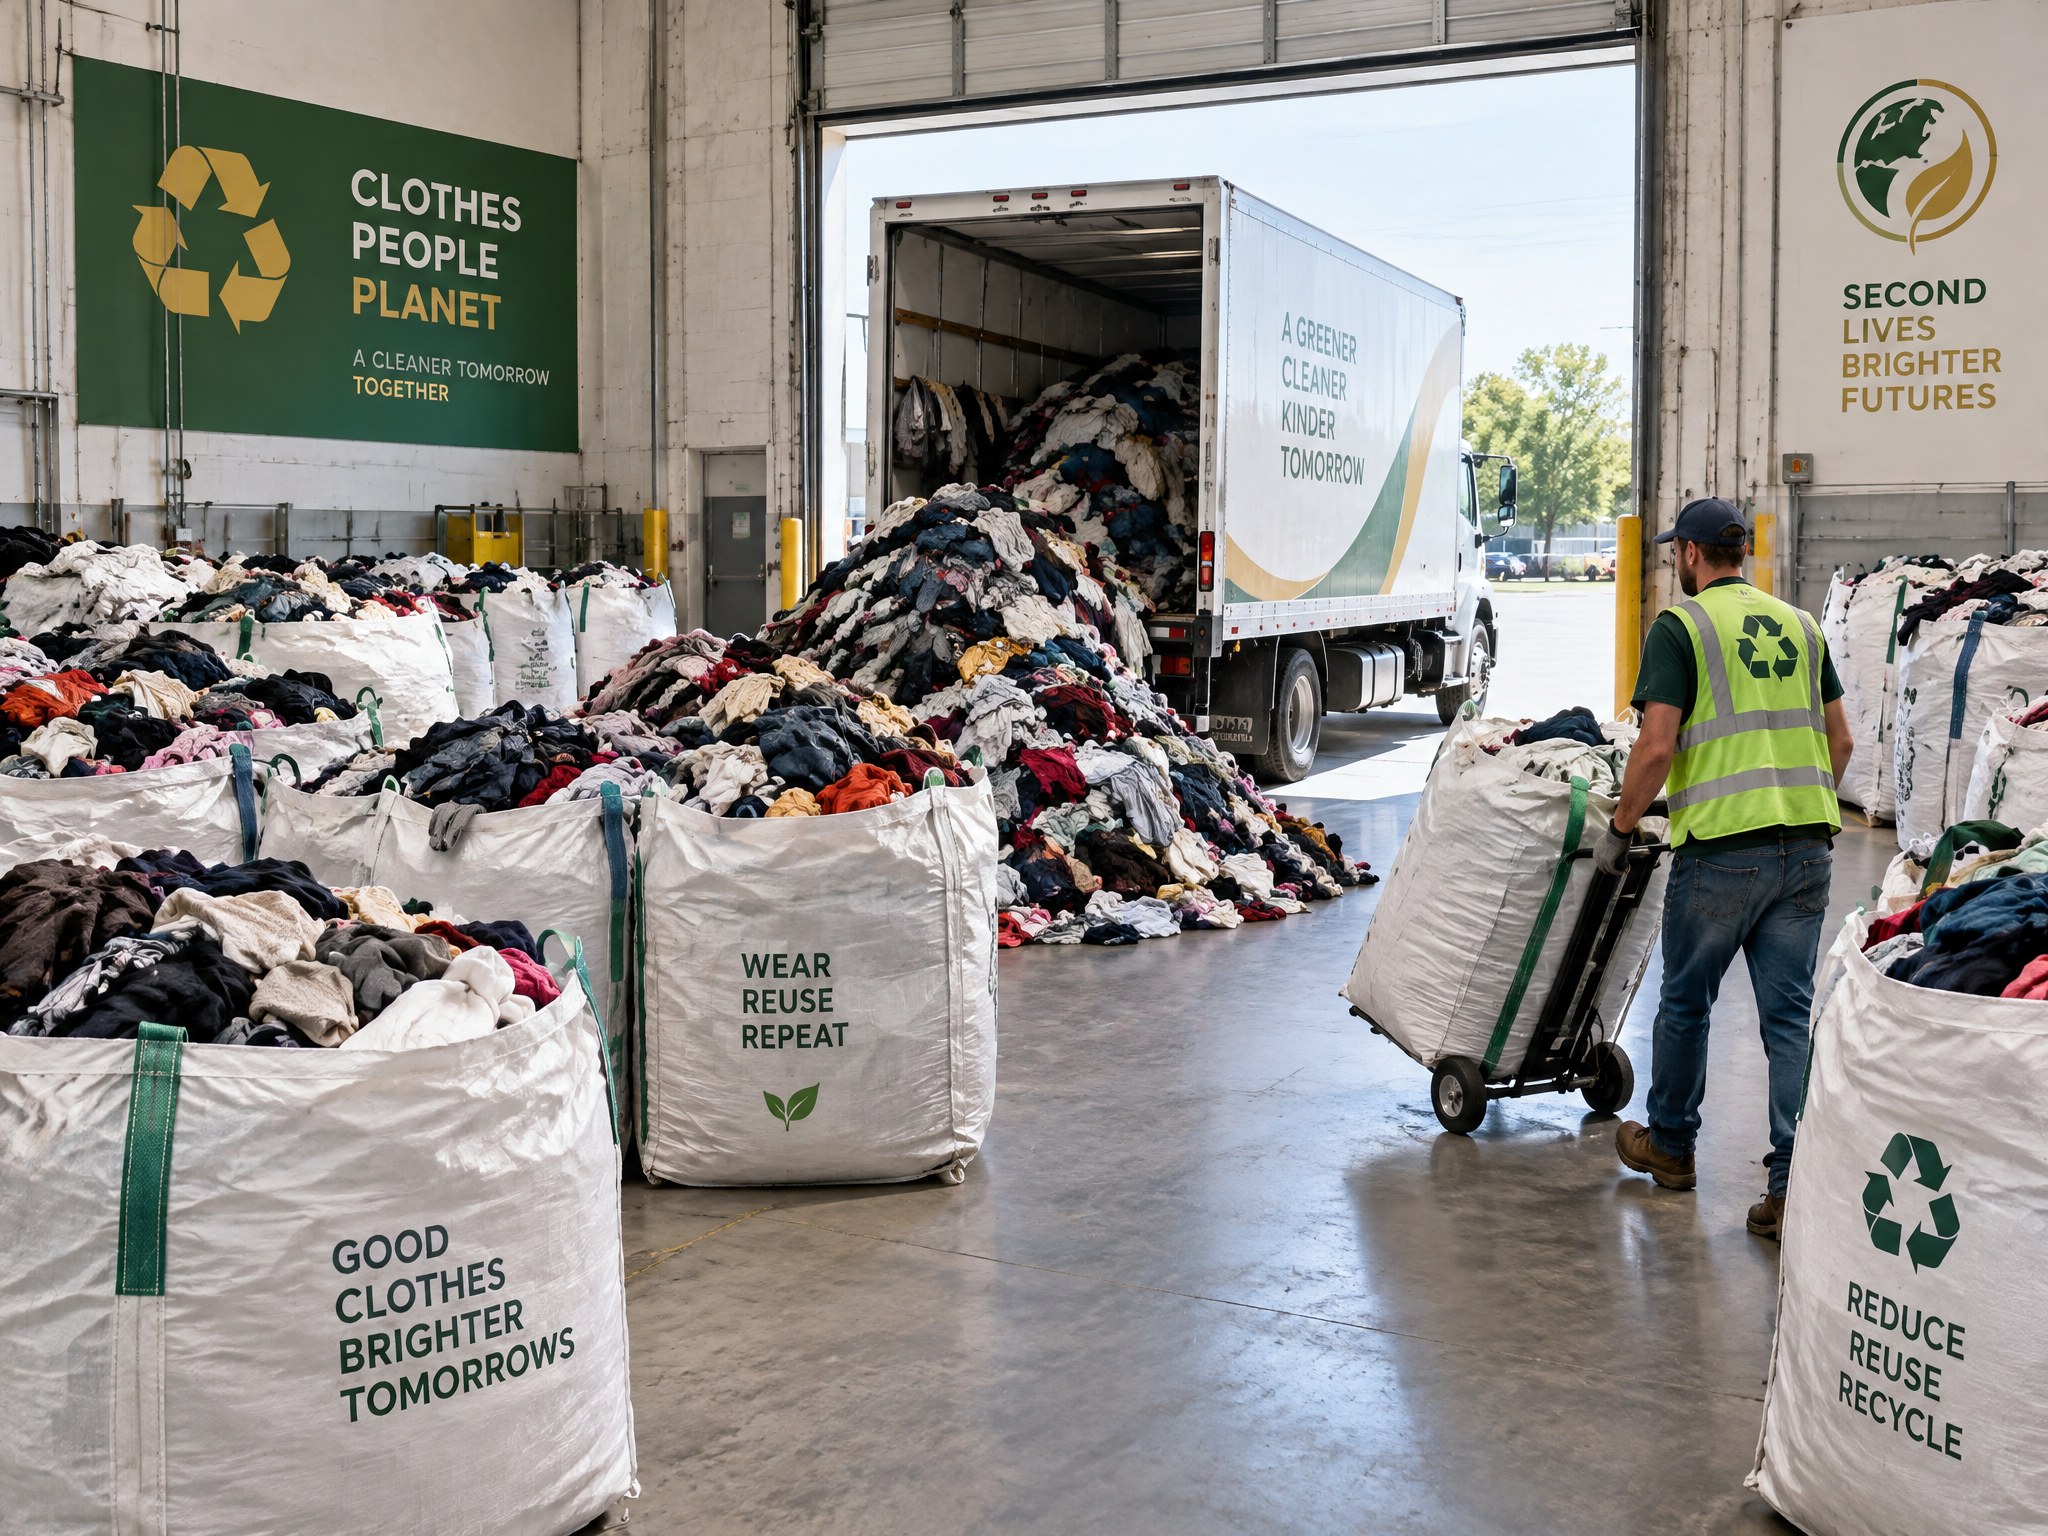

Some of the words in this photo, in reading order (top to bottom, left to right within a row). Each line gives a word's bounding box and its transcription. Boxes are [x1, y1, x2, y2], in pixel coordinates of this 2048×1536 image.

[351, 168, 522, 232] CLOTHES
[352, 221, 499, 280] PEOPLE
[353, 276, 502, 331] PLANET
[1842, 278, 1987, 310] SECOND
[1281, 311, 1293, 344] A
[1296, 316, 1357, 365] GREENER
[1843, 315, 1936, 345] LIVES
[352, 348, 366, 368] A
[372, 350, 452, 377] CLEANER
[457, 360, 550, 386] TOMORROW
[1281, 355, 1347, 402] CLEANER
[1842, 347, 2002, 378] BRIGHTER
[352, 375, 449, 404] TOGETHER
[1841, 382, 1997, 413] FUTURES
[1281, 399, 1336, 441] KINDER
[1280, 445, 1366, 486] TOMORROW
[741, 952, 832, 979] WEAR
[742, 987, 834, 1014] REUSE
[742, 1021, 849, 1050] REPEAT
[332, 1224, 449, 1275] GOOD
[335, 1257, 506, 1324] CLOTHES
[339, 1299, 525, 1375] BRIGHTER
[1847, 1280, 1966, 1361] REDUCE
[339, 1326, 576, 1424] TOMORROWS
[1849, 1329, 1942, 1403] REUSE
[1838, 1370, 1963, 1461] RECYCLE
